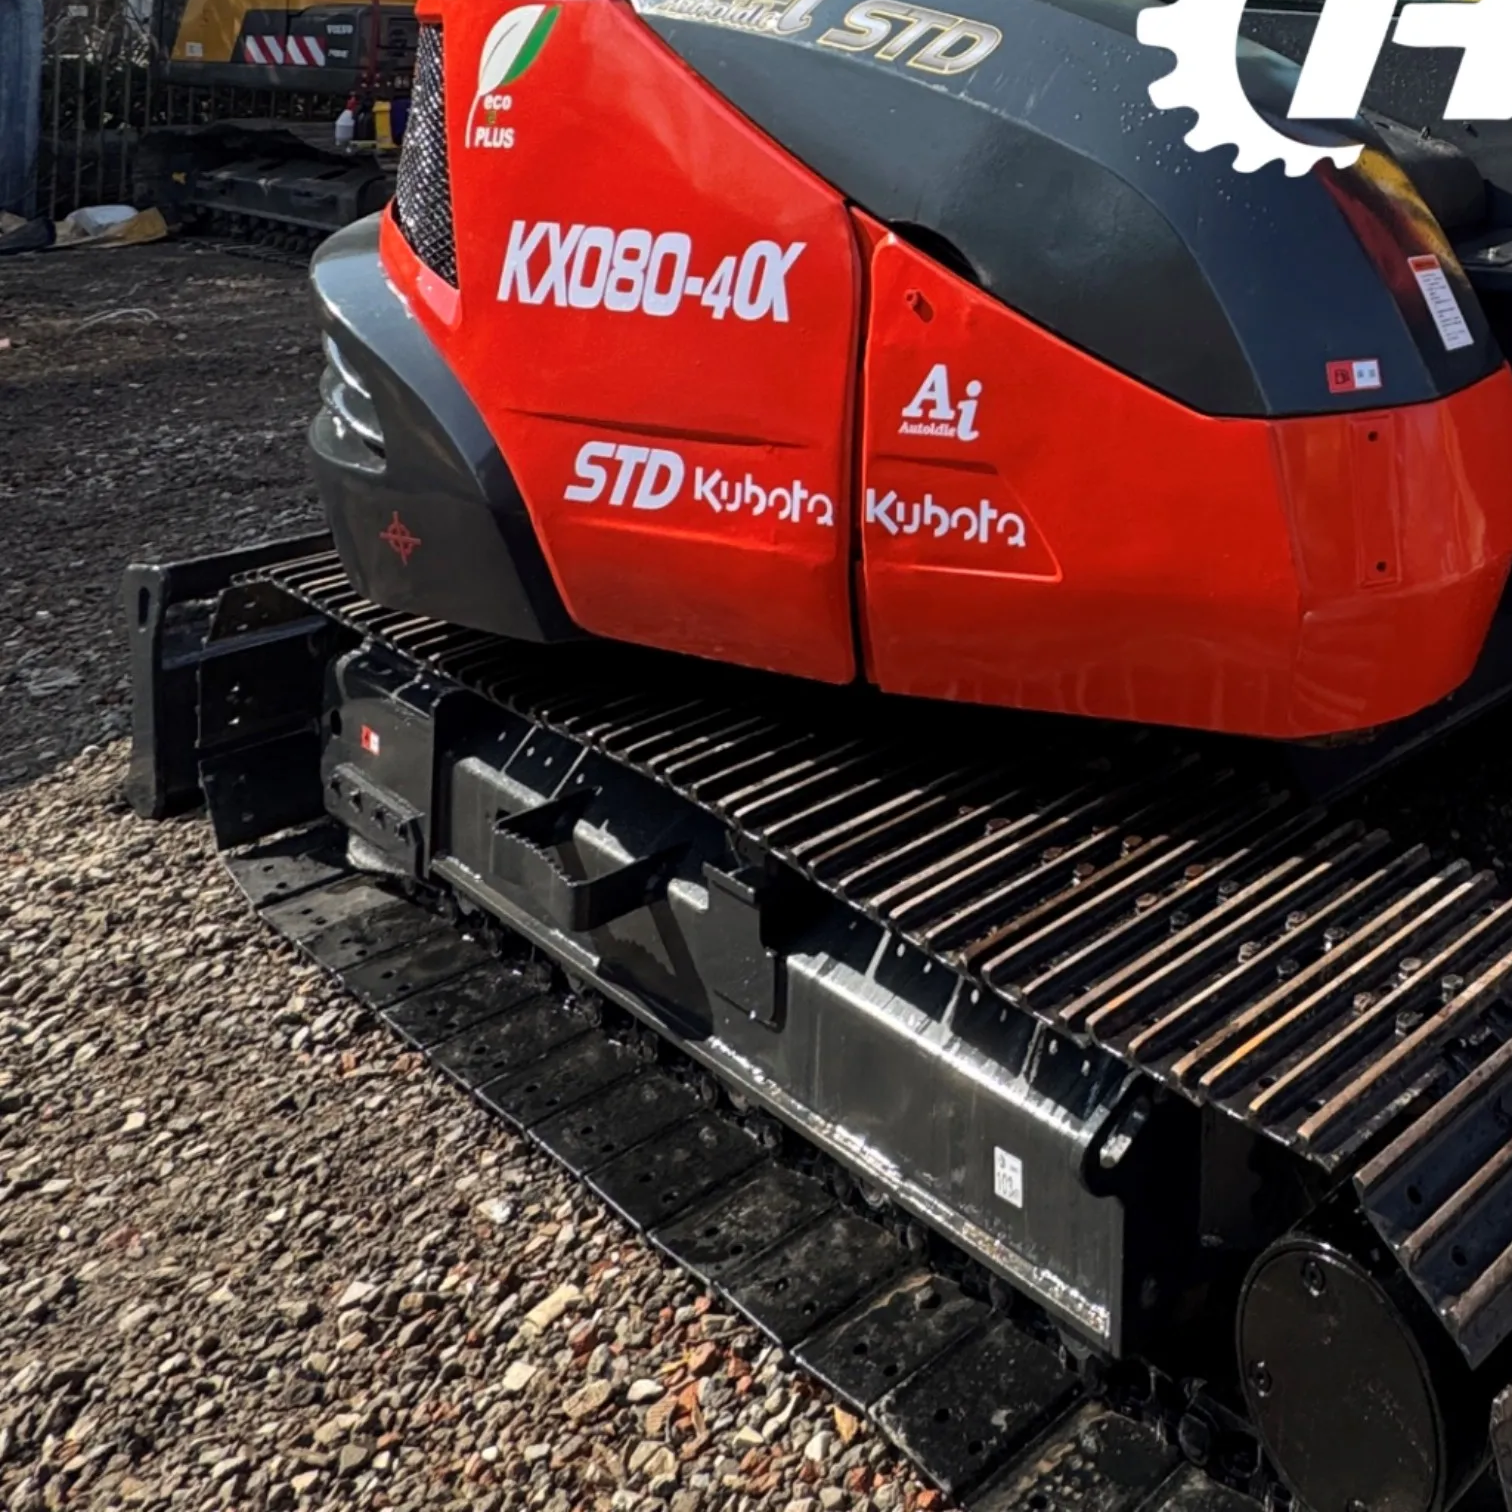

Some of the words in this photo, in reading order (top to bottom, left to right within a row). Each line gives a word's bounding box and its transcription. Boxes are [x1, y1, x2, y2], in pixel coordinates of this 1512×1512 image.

[483, 94, 513, 111] eco
[474, 125, 516, 149] PLUS
[901, 361, 982, 442] Ai
[563, 440, 685, 510] STD
[693, 466, 834, 527] Kubota
[865, 488, 1027, 547] Kubota
